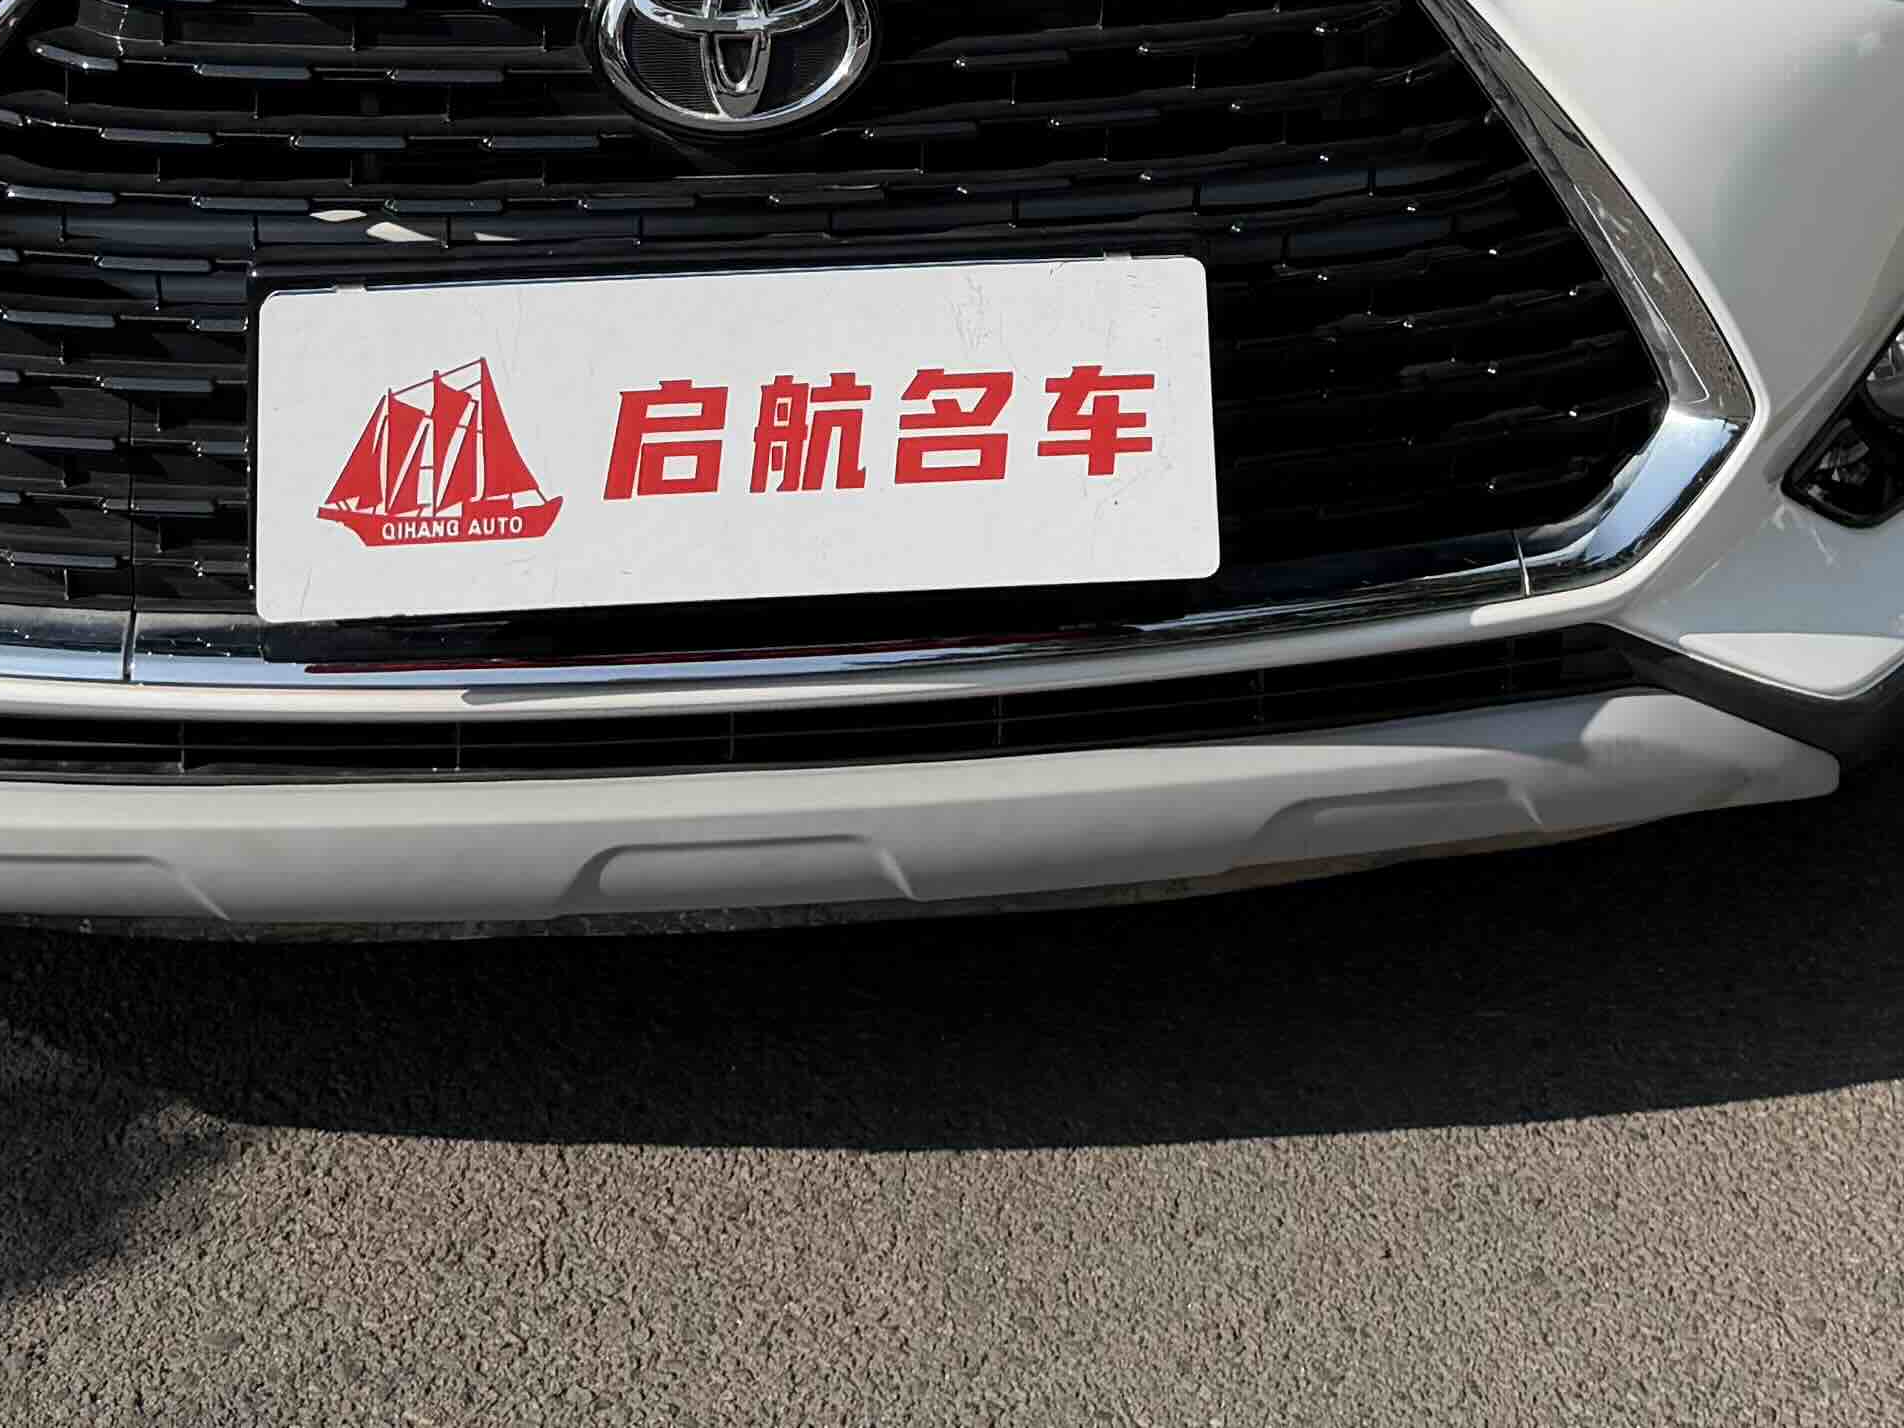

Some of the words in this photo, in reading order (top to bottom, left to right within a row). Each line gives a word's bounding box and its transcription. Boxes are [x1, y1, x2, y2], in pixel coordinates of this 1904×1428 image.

[604, 365, 1154, 500] 启航名车
[382, 520, 460, 540] QIHANG
[467, 515, 523, 535] AUTO
